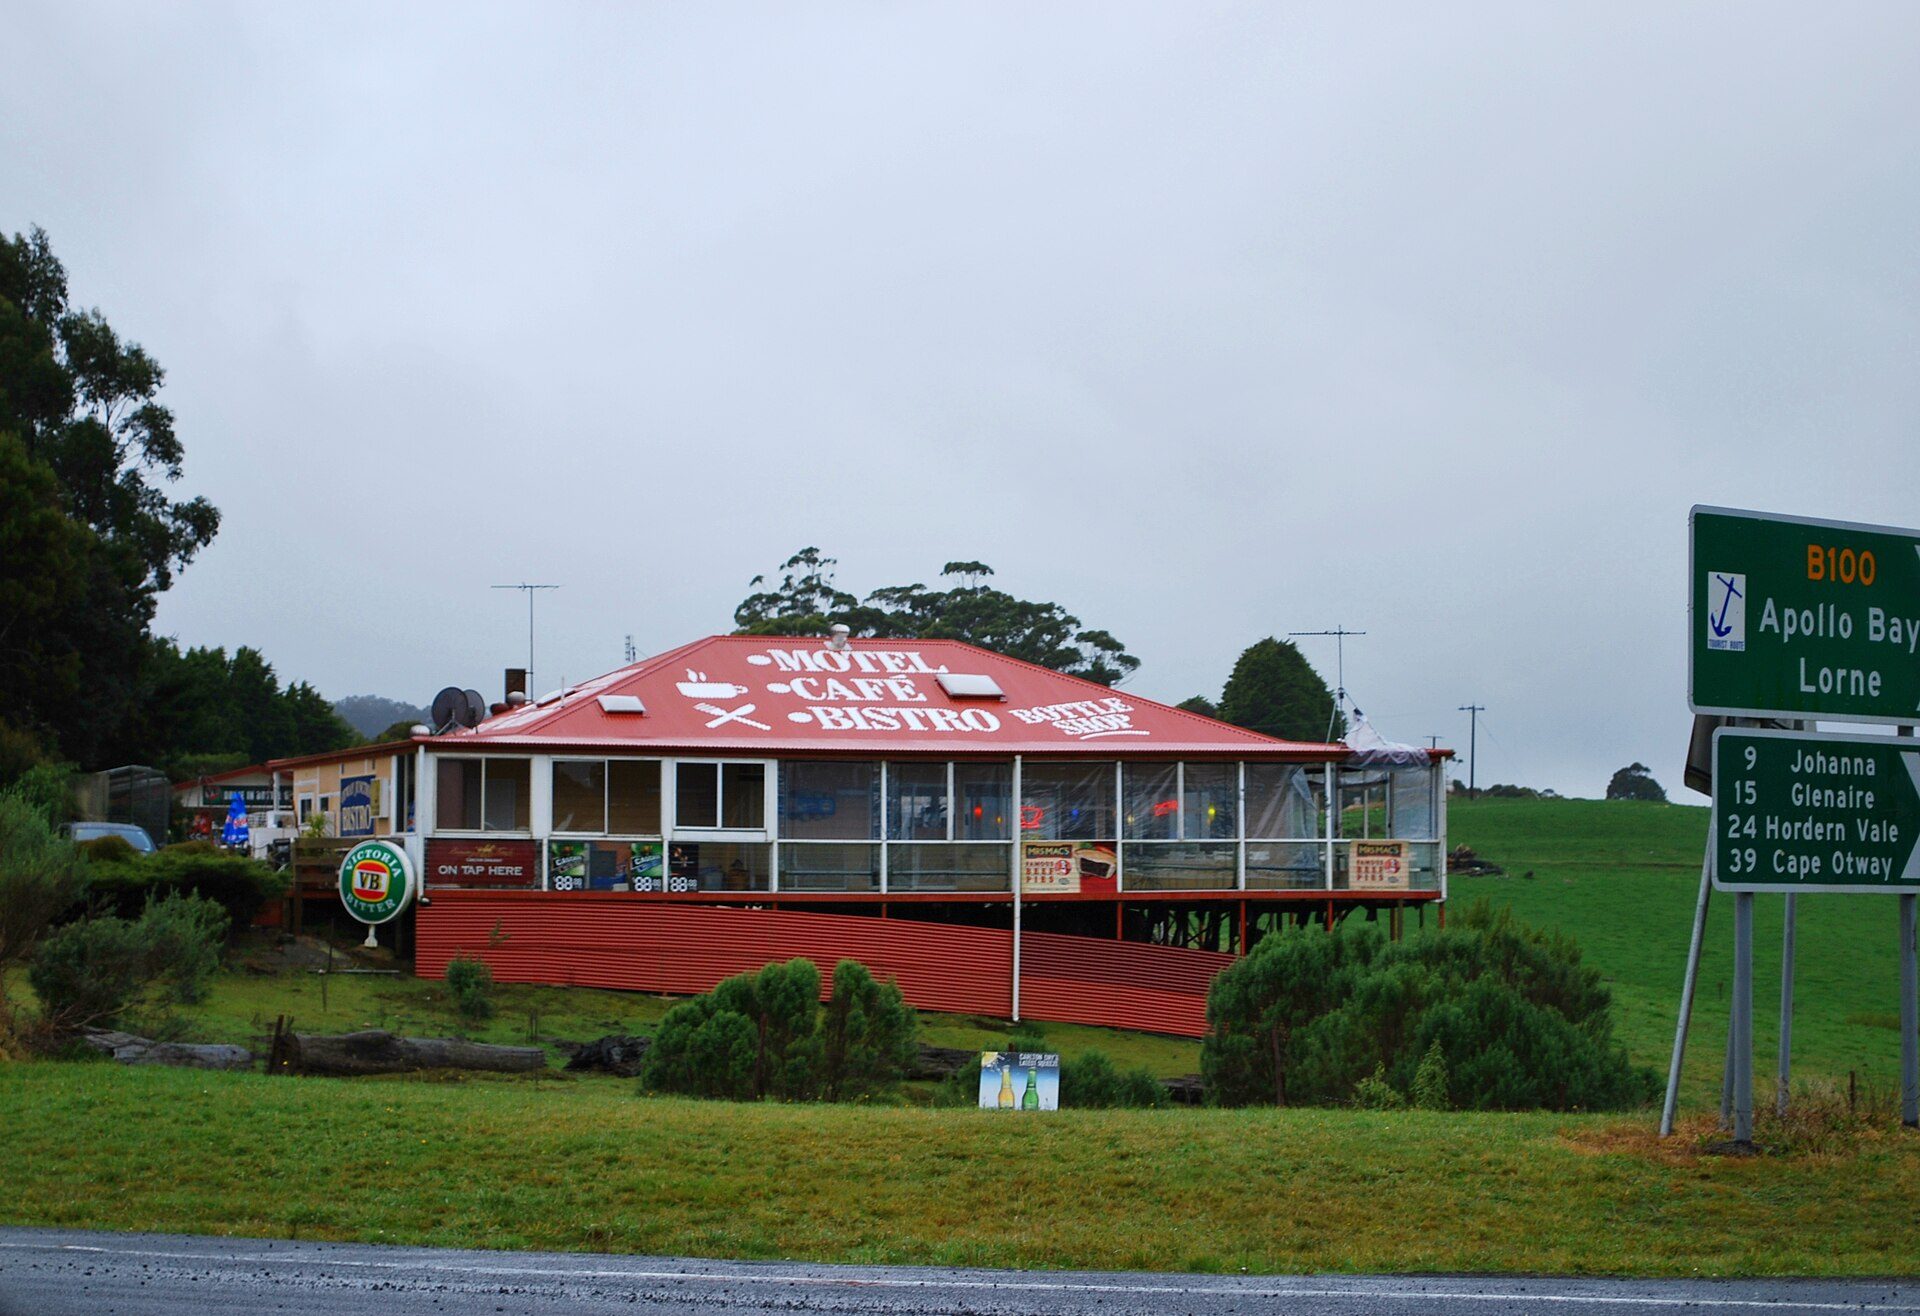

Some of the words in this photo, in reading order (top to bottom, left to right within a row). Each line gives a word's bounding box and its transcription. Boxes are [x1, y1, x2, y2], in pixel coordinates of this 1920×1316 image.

[1807, 544, 1876, 586] B100
[1759, 597, 1852, 643] Apollo
[1869, 607, 1920, 654] Bay
[766, 649, 949, 674] MOTEL
[789, 674, 928, 702] CAFÉ
[1800, 657, 1881, 697] Lorne
[806, 706, 1001, 733] BISTRO
[1008, 697, 1135, 724] BOTTLE
[1052, 713, 1134, 735] SHOP
[1744, 746, 1757, 771] 9
[1791, 750, 1876, 777] Johanna
[1734, 780, 1757, 805] 15
[1791, 782, 1875, 809] Glenaire
[1728, 814, 1757, 840] 24
[1765, 815, 1846, 843] Hordern
[1857, 819, 1899, 843] Vale
[345, 849, 402, 878] VICTORIA
[438, 864, 458, 876] ON
[461, 864, 485, 876] TAP
[488, 865, 523, 876] HERE
[1729, 848, 1757, 873] 39
[1773, 849, 1821, 880] Cape
[1832, 854, 1892, 881] Otway
[359, 871, 382, 890] VB
[346, 892, 396, 913] BITTER
